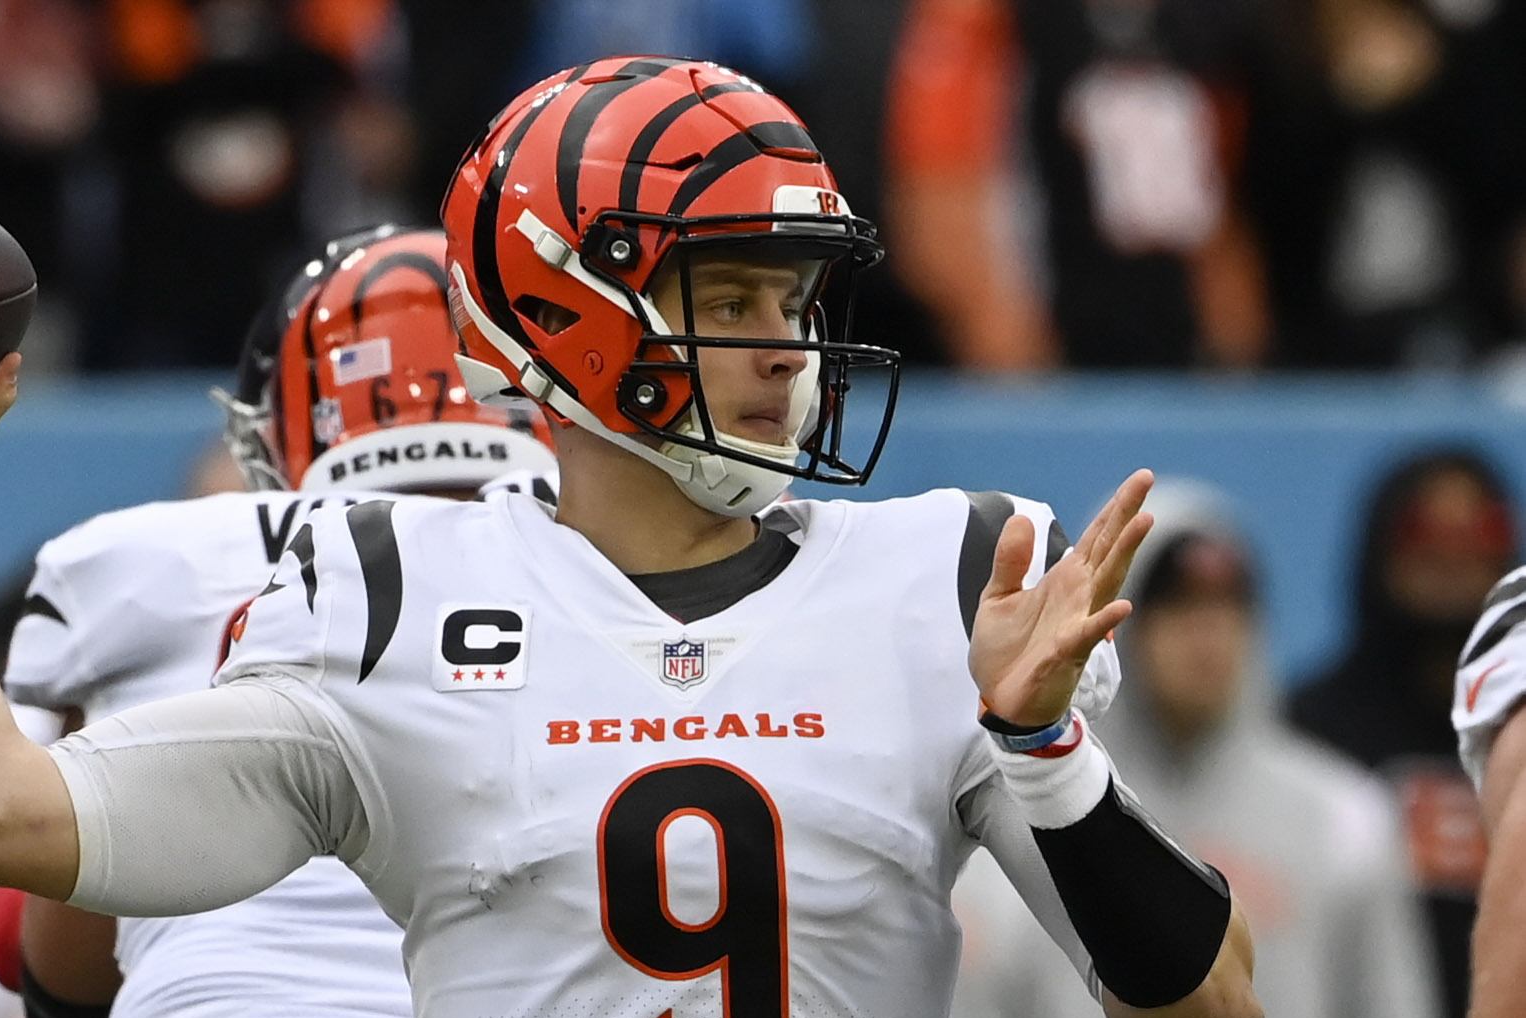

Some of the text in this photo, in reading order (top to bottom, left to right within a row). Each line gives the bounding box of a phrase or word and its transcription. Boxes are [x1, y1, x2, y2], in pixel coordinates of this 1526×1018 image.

[330, 441, 508, 483] BENGALS
[441, 609, 524, 665] C
[667, 658, 701, 679] NFL
[546, 712, 826, 746] BENGALS
